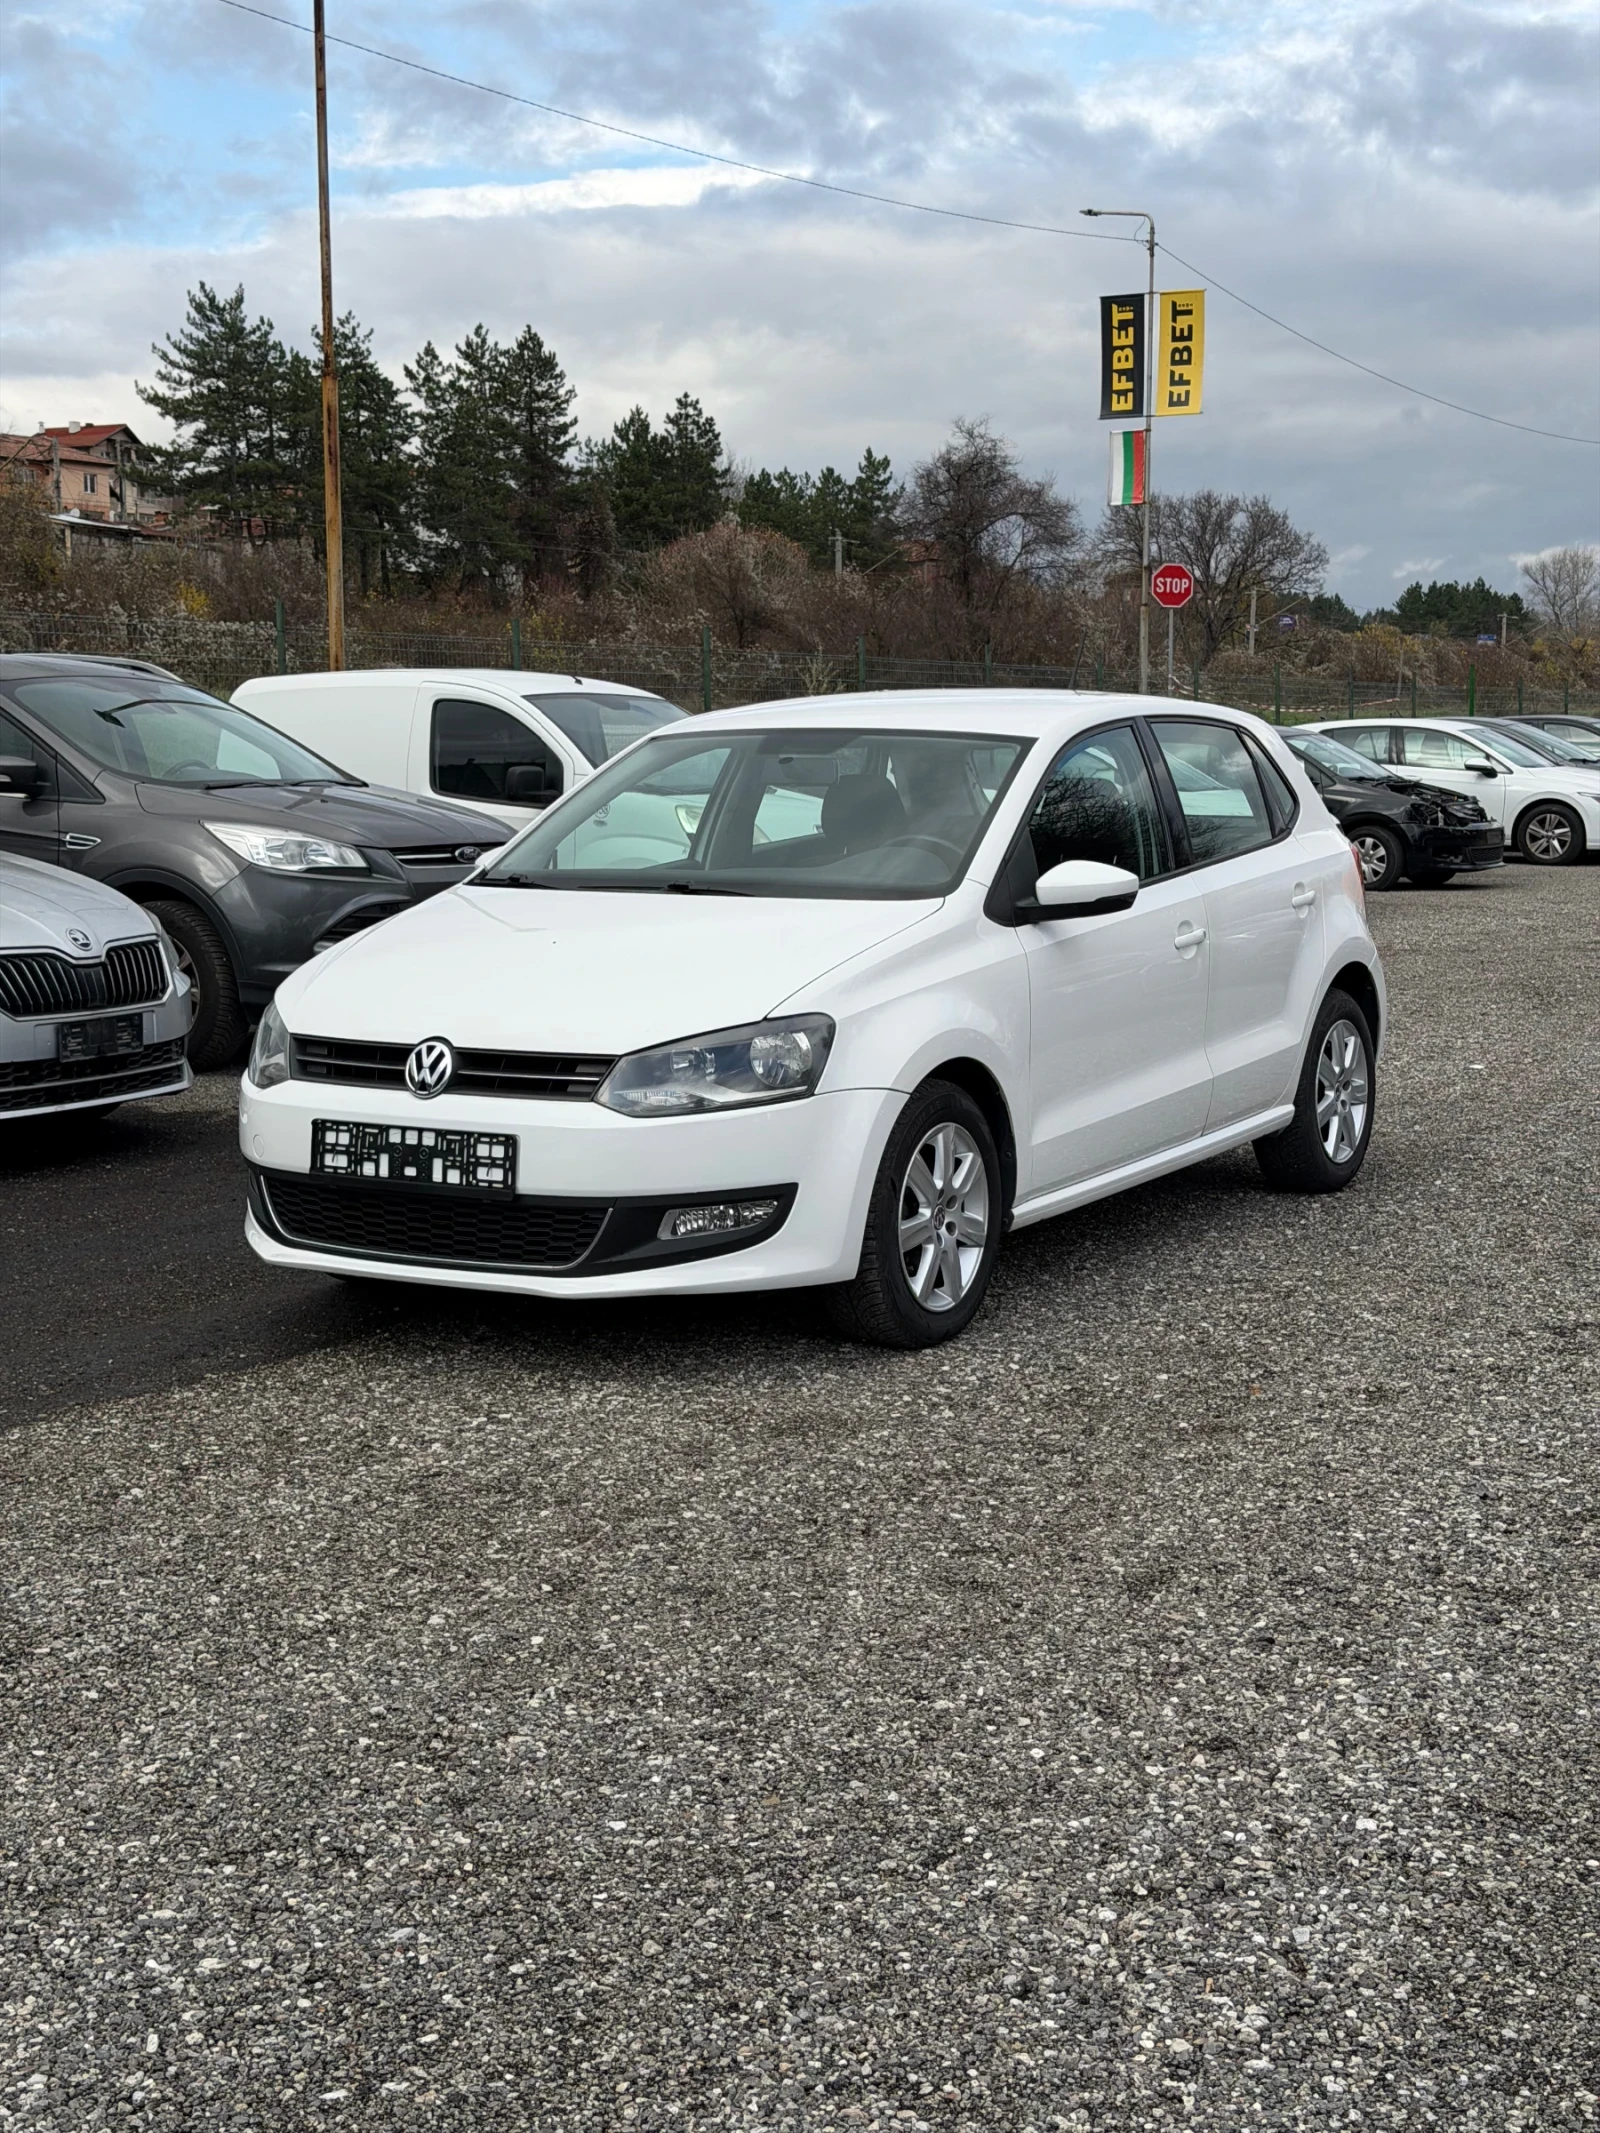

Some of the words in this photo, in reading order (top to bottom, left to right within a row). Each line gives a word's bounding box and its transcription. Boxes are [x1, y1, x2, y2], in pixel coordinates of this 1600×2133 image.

[1112, 303, 1134, 412] EFBET
[1168, 300, 1193, 408] EFBET
[1155, 577, 1190, 594] STOP
[407, 1043, 450, 1094] VW
